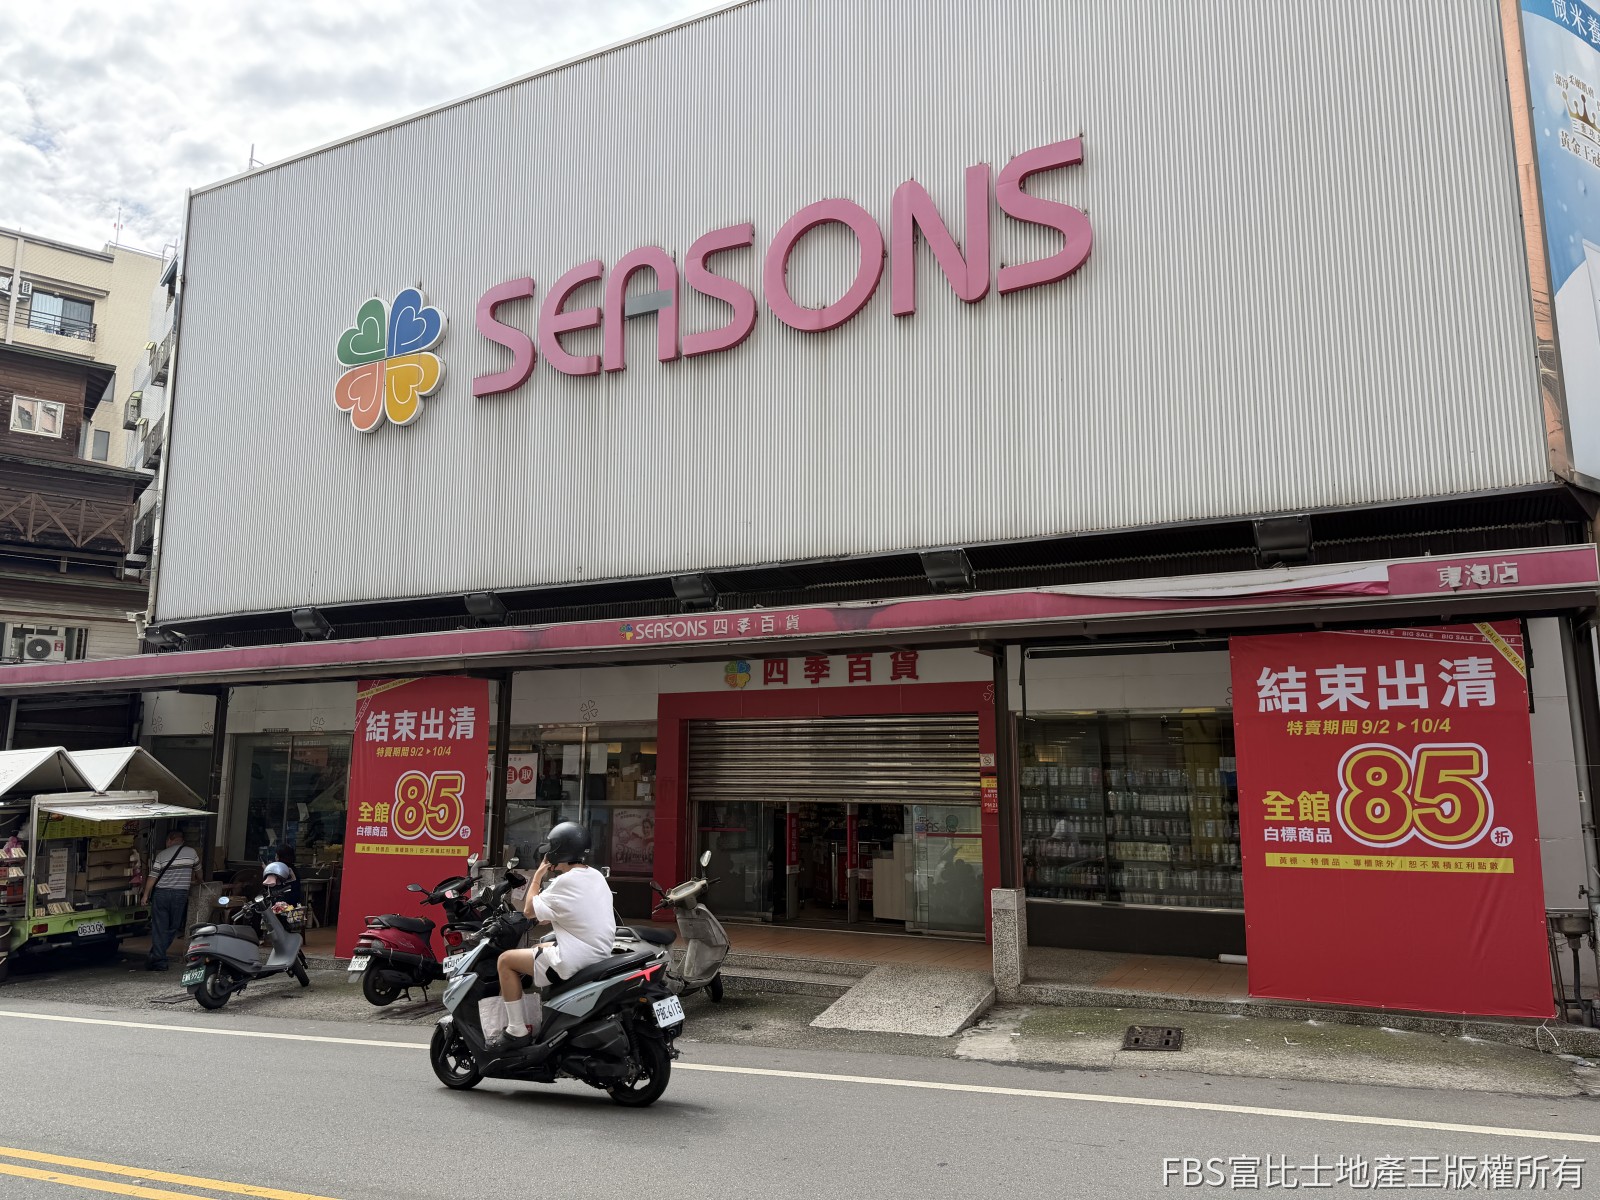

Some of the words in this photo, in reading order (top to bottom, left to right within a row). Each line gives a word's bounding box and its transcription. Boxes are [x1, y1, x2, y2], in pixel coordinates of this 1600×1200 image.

[472, 134, 1094, 398] SEASONS
[1437, 561, 1519, 588] 東海店
[635, 619, 708, 640] SEASONS
[713, 614, 800, 636] 四季百貨
[1402, 630, 1415, 638] BIG
[1416, 631, 1434, 639] SALE
[1441, 633, 1455, 641] BIG
[1455, 634, 1474, 642] SALE
[763, 651, 919, 686] 四季百貨
[1256, 656, 1497, 713] 結束出清
[365, 705, 476, 743] 結束出清
[1361, 719, 1390, 735] 9/2
[1410, 717, 1452, 733] 10/4
[391, 769, 466, 841] 85
[1262, 790, 1331, 823] 全館
[1336, 742, 1495, 849] 85
[357, 801, 390, 824] 全館
[356, 825, 388, 837] 白標商品
[1263, 826, 1333, 844] 白標商品
[1494, 829, 1510, 844] 折
